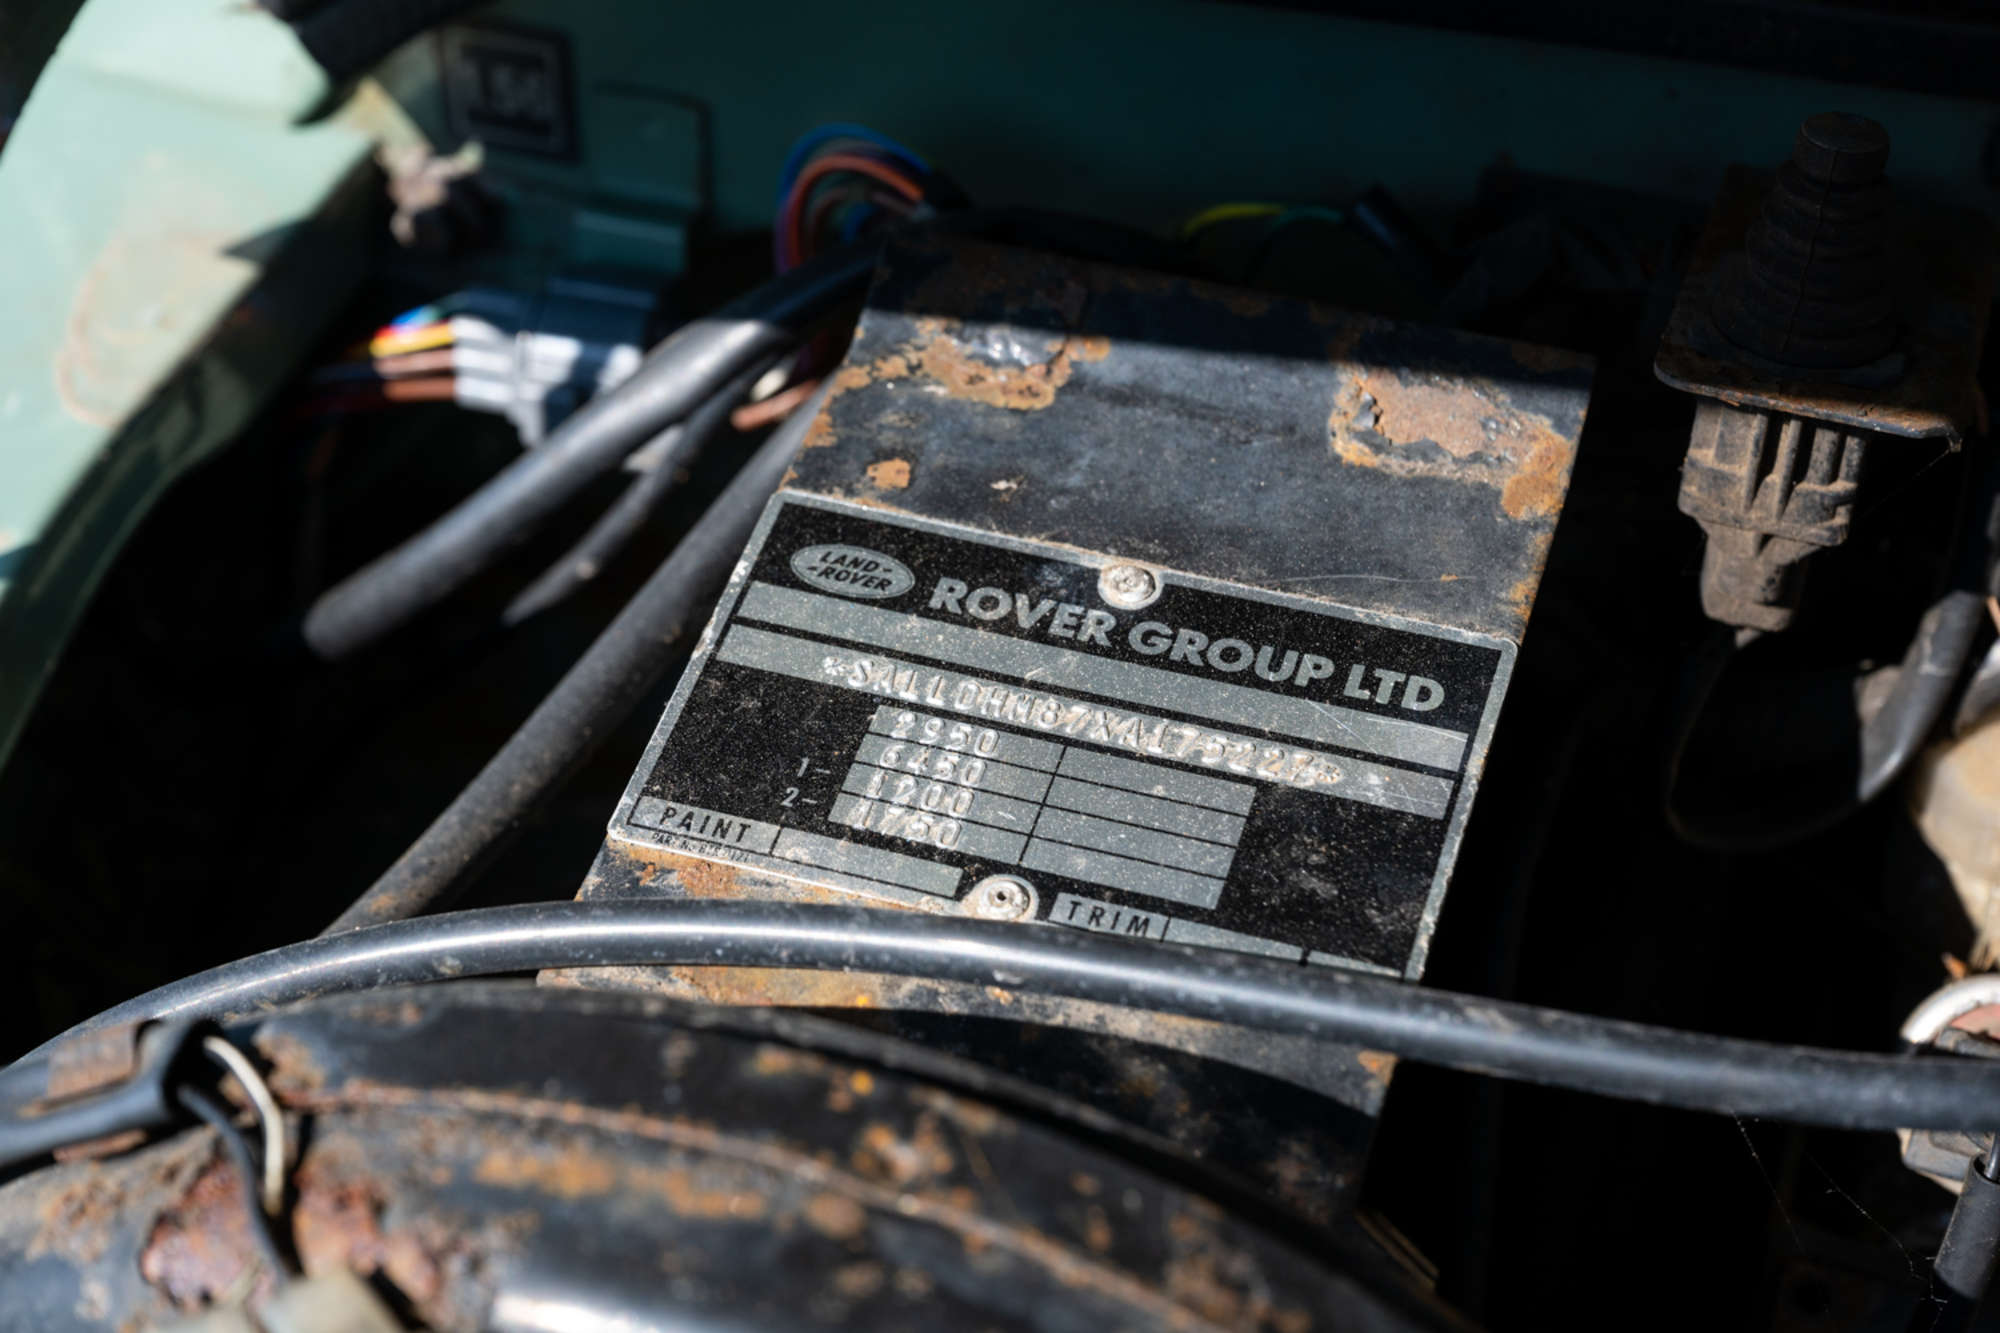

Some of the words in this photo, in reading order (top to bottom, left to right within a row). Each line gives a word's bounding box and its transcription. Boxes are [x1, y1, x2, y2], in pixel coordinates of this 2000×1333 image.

[928, 576, 1117, 648] ROVER
[1127, 619, 1334, 687] GROUP
[1342, 662, 1446, 712] LTD
[890, 711, 1000, 757] 2950
[879, 745, 987, 787] 6450
[866, 770, 975, 818] 1200
[659, 806, 751, 843] PAINT
[1068, 900, 1150, 938] TRIM
